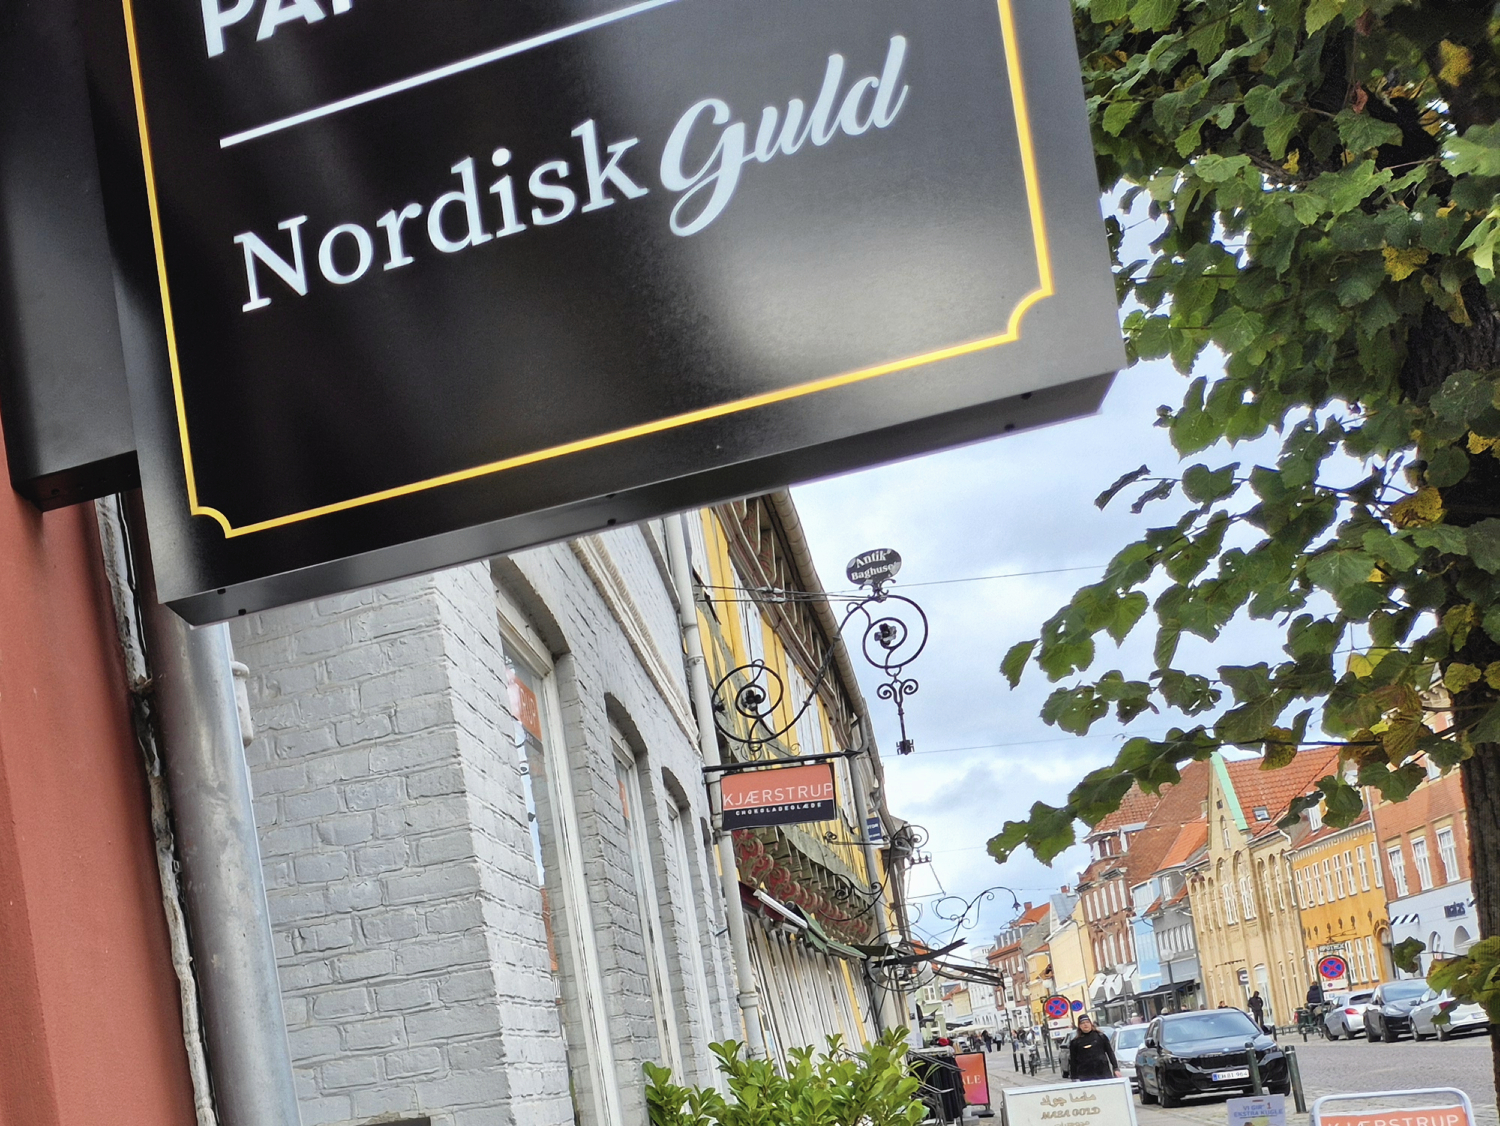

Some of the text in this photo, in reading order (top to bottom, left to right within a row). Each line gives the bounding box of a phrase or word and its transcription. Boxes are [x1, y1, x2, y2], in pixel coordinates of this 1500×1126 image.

[202, 0, 352, 58] PA
[233, 34, 910, 312] Nordisk Guld
[856, 550, 887, 568] Antik
[723, 783, 834, 806] KJÆRSTRUP
[735, 802, 822, 816] CHOKOLADEGLÆDE
[1072, 1107, 1101, 1117] GOLD
